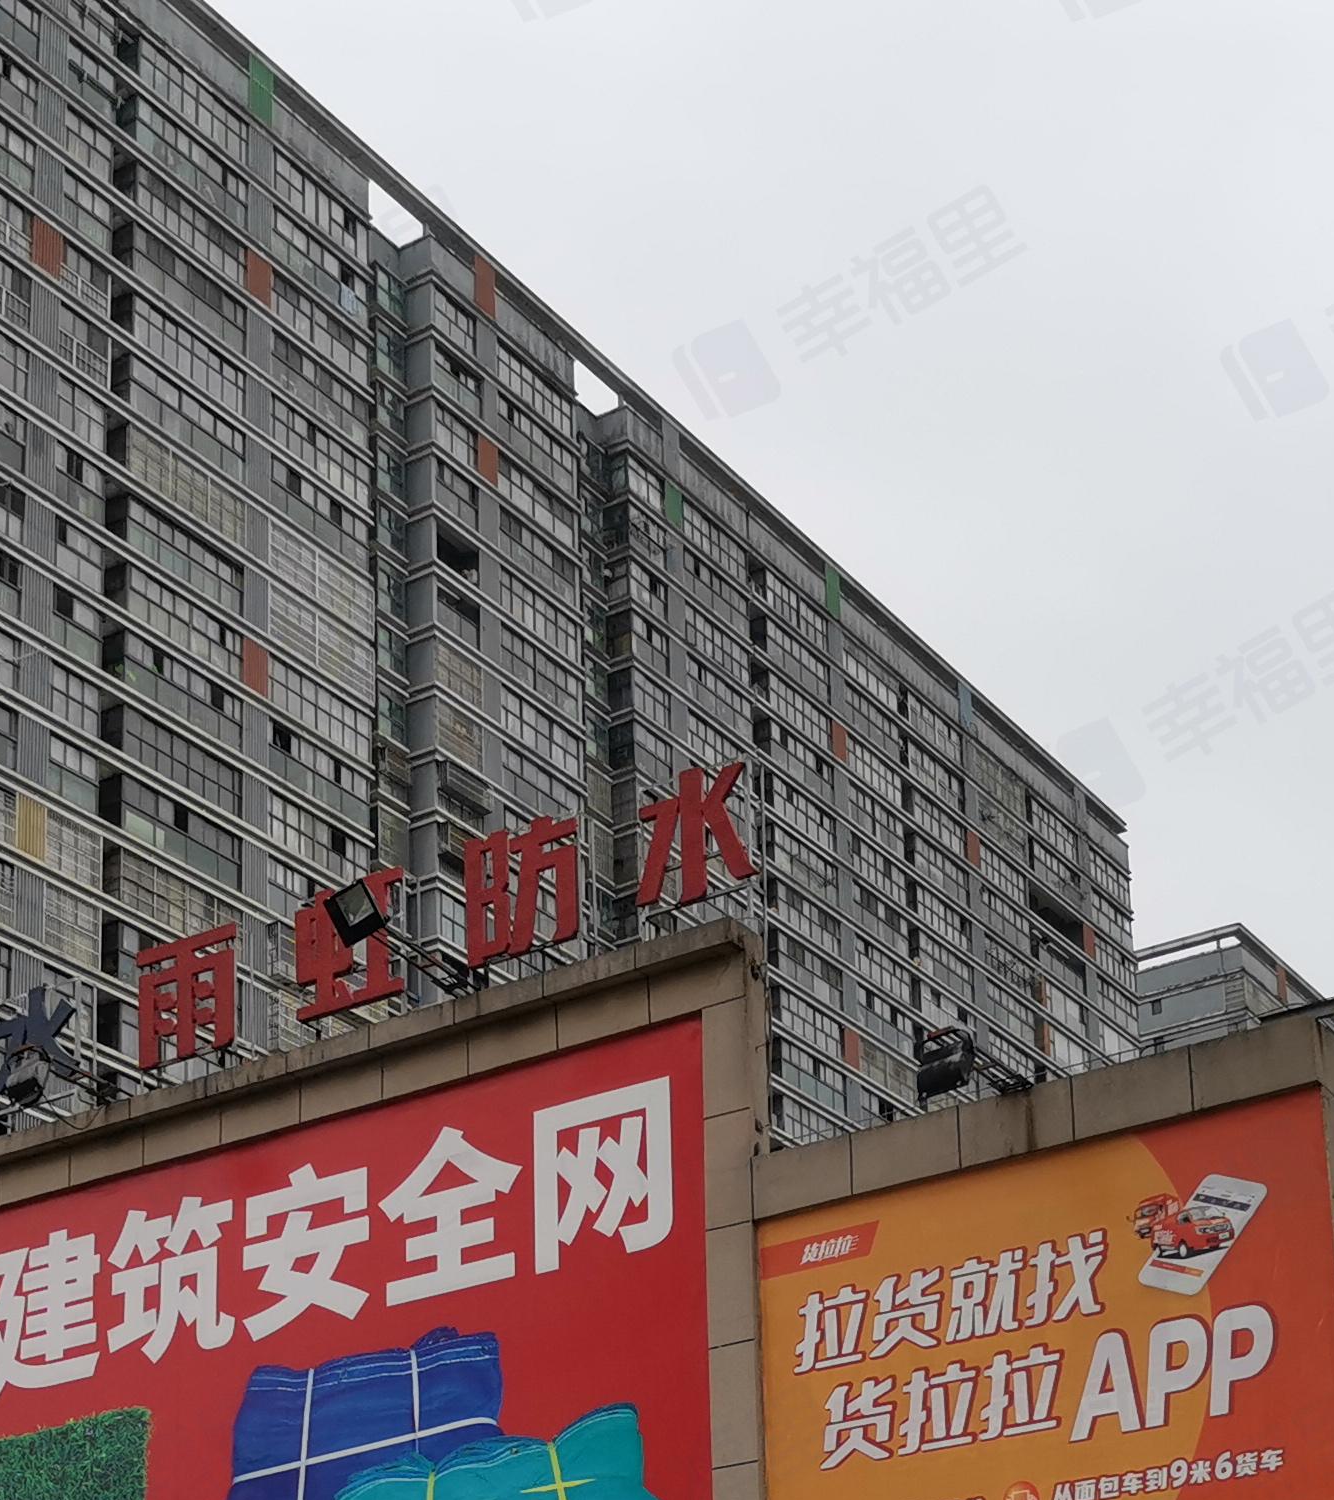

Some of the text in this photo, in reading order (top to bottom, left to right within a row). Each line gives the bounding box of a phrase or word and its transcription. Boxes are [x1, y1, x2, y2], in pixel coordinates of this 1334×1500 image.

[136, 762, 759, 1071] 雨虹防水
[793, 1231, 1107, 1375] 拉货就找
